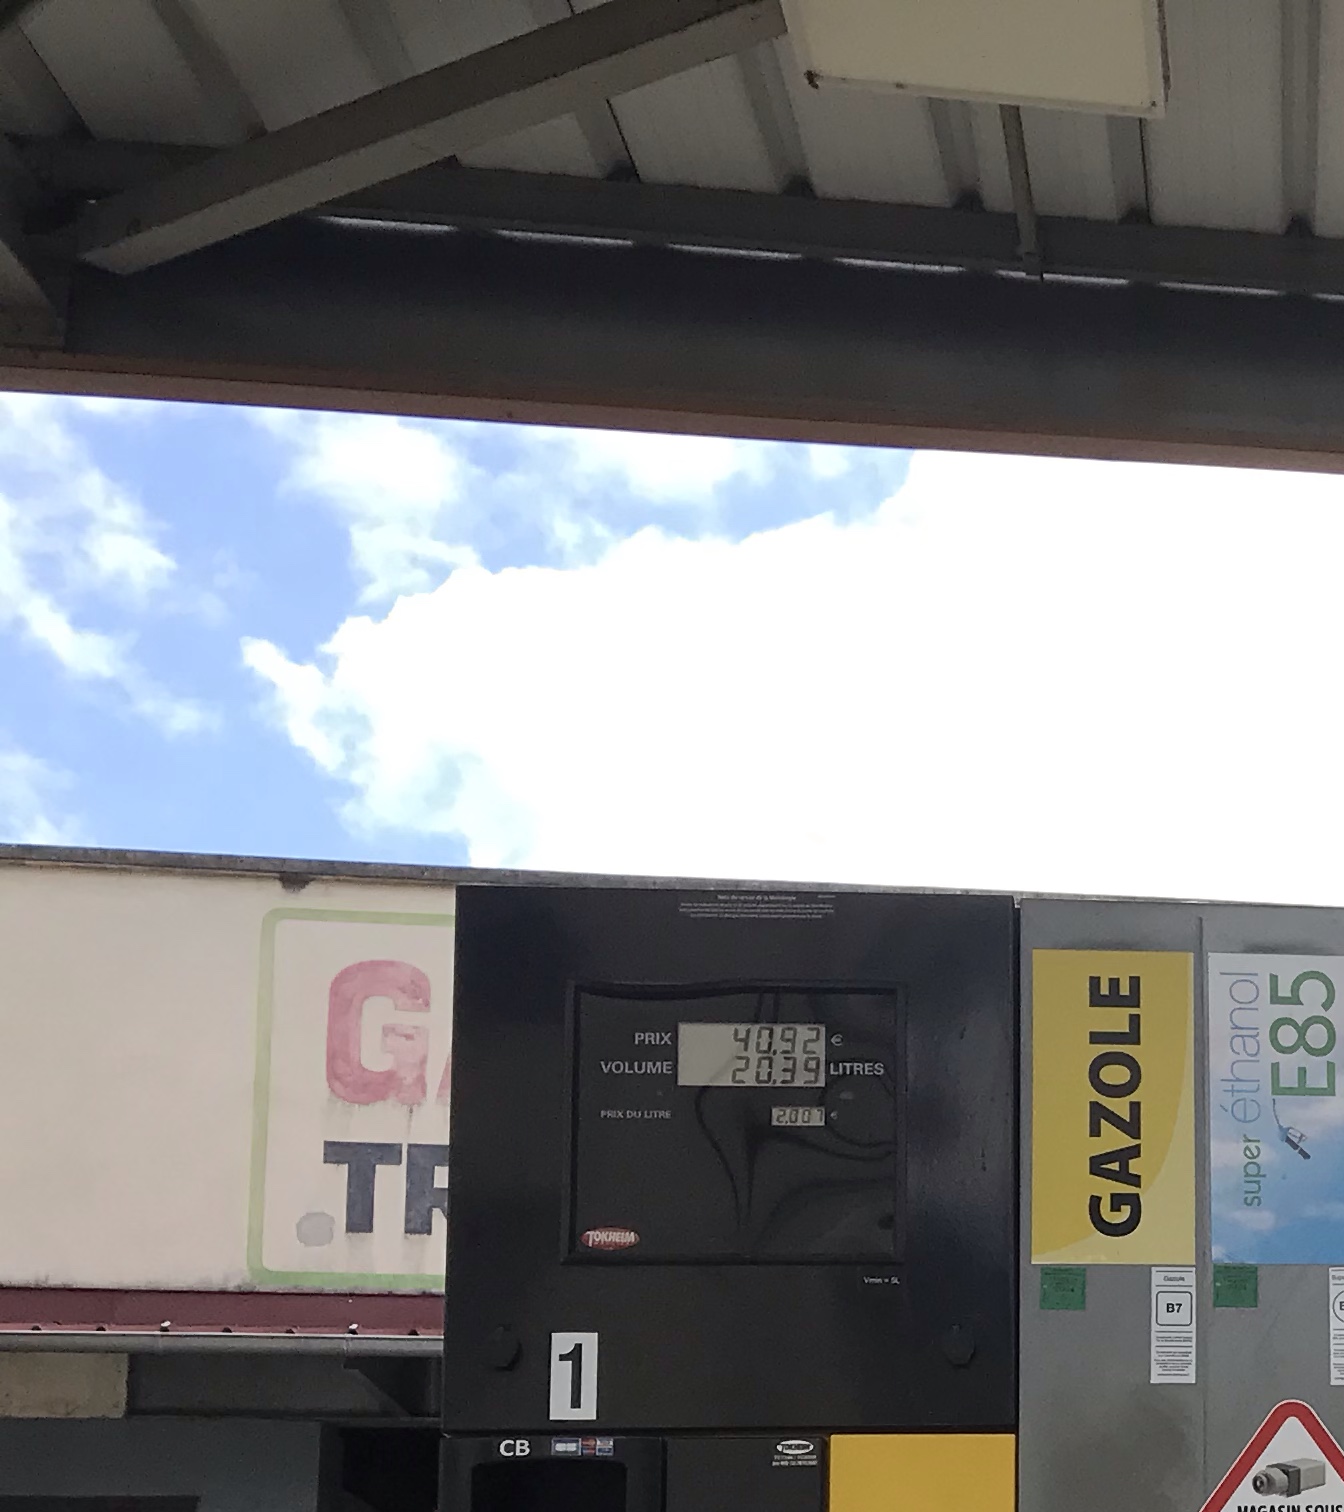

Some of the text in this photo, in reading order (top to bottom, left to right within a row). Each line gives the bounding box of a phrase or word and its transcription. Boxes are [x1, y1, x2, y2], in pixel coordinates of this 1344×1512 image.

[634, 1032, 672, 1045] PRIX
[1270, 969, 1337, 1099] E85
[600, 1061, 673, 1074] VOLUME
[830, 1063, 884, 1075] LITRES
[1219, 969, 1267, 1207] super éthanol
[1088, 974, 1142, 1238] GAZOLE
[600, 1110, 671, 1119] PRIX DU LITRE
[1166, 1303, 1183, 1313] B7
[558, 1343, 583, 1409] 1
[499, 1439, 530, 1456] CB
